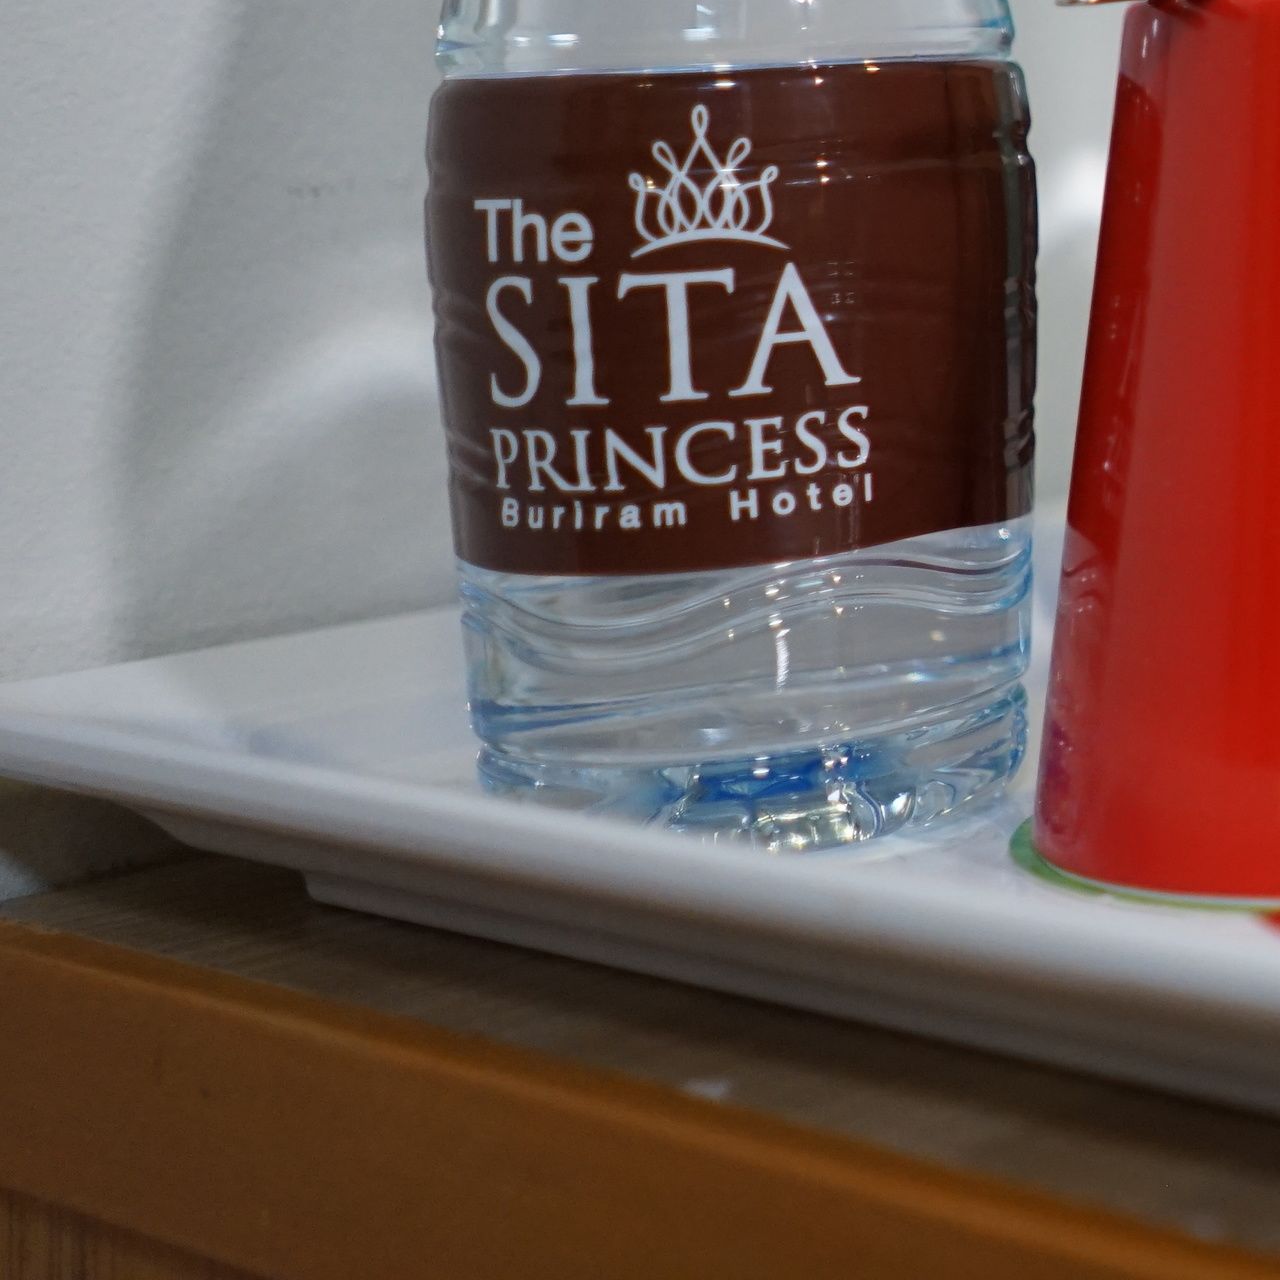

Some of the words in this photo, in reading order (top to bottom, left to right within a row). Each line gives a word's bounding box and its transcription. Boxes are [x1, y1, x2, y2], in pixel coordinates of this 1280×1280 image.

[474, 198, 595, 263] The
[485, 261, 862, 408] SITA
[489, 405, 872, 495] PRINCESS
[501, 497, 688, 530] Buriram
[729, 472, 873, 521] Hotel
